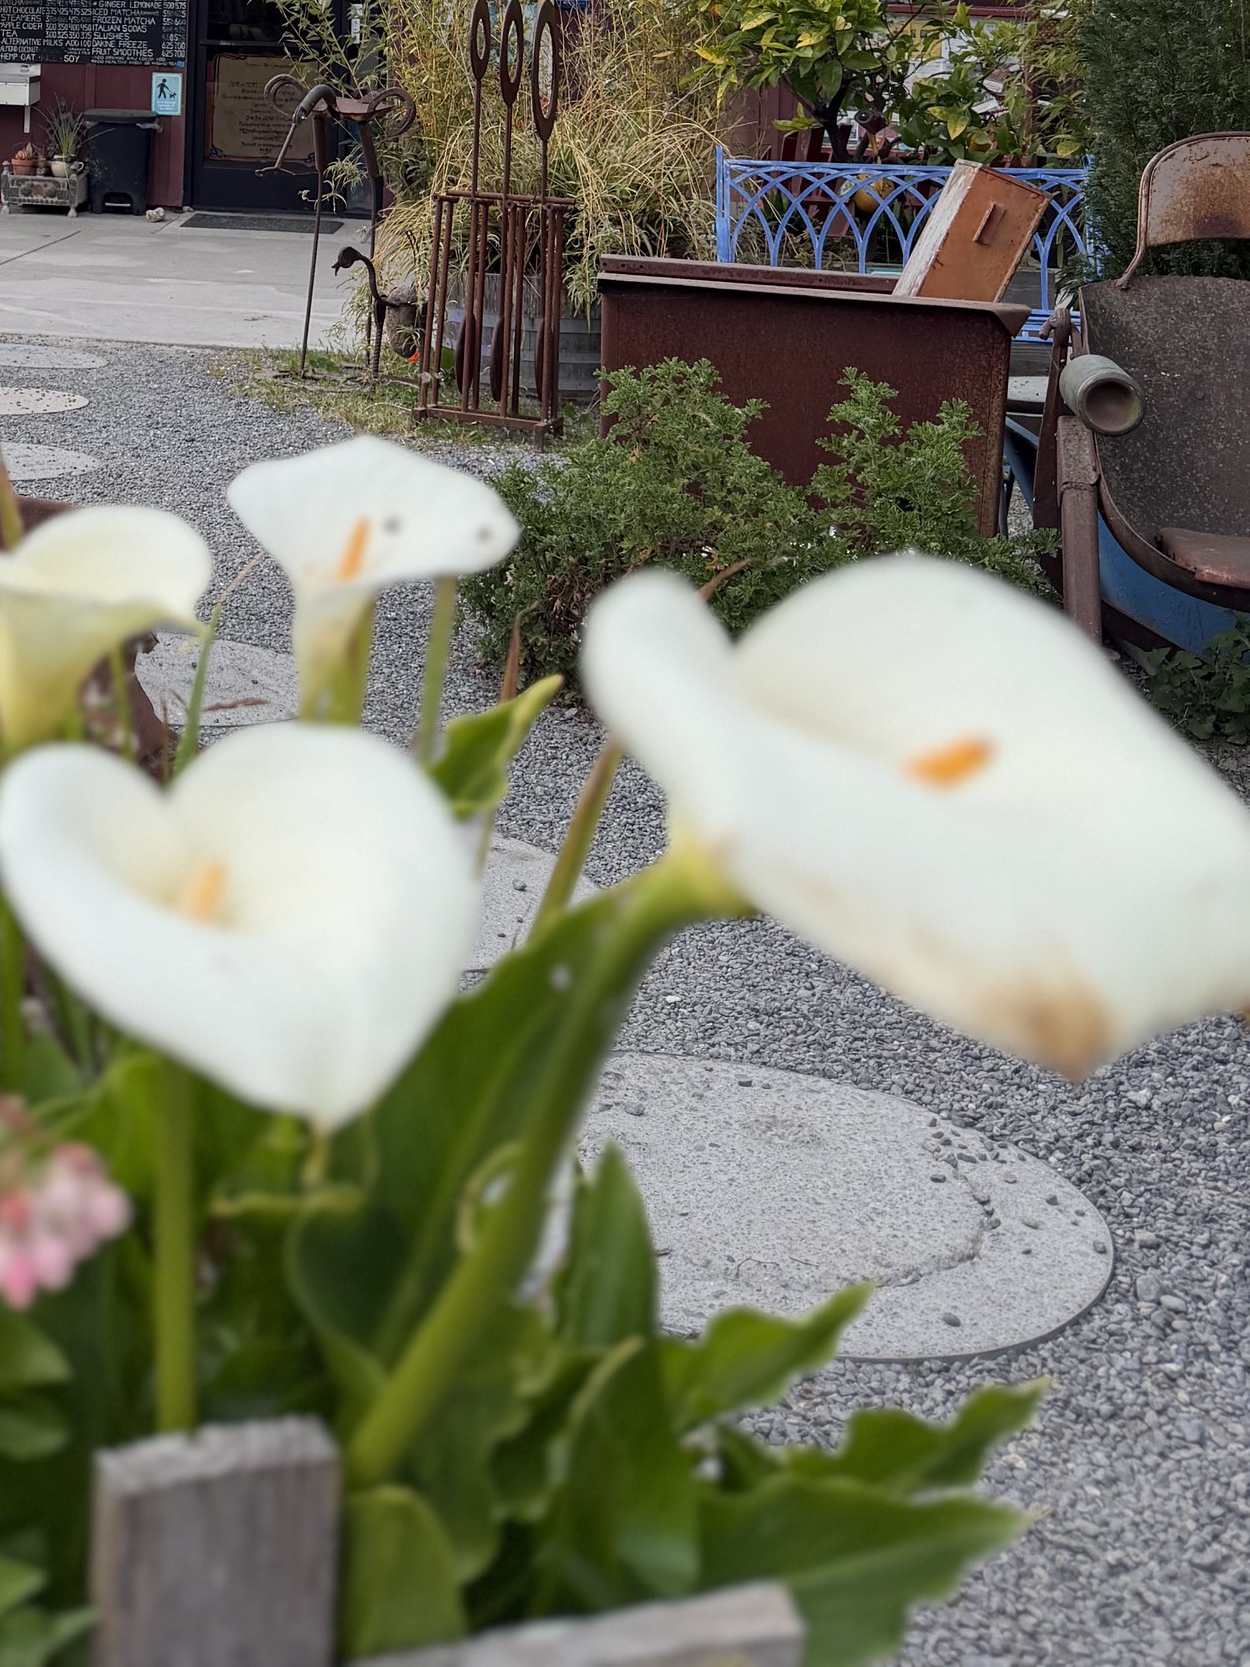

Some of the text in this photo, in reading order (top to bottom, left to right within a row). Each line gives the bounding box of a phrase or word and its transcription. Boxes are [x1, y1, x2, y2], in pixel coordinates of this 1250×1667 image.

[0, 6, 12, 14] HOT
[93, 8, 108, 16] ICED
[22, 22, 42, 30] CIDER
[92, 24, 120, 32] ITALIAN
[94, 32, 130, 40] SLUSHIES
[1, 38, 42, 46] ALTERNATIVE
[92, 48, 111, 56] FRUIT
[64, 54, 80, 62] SOY
